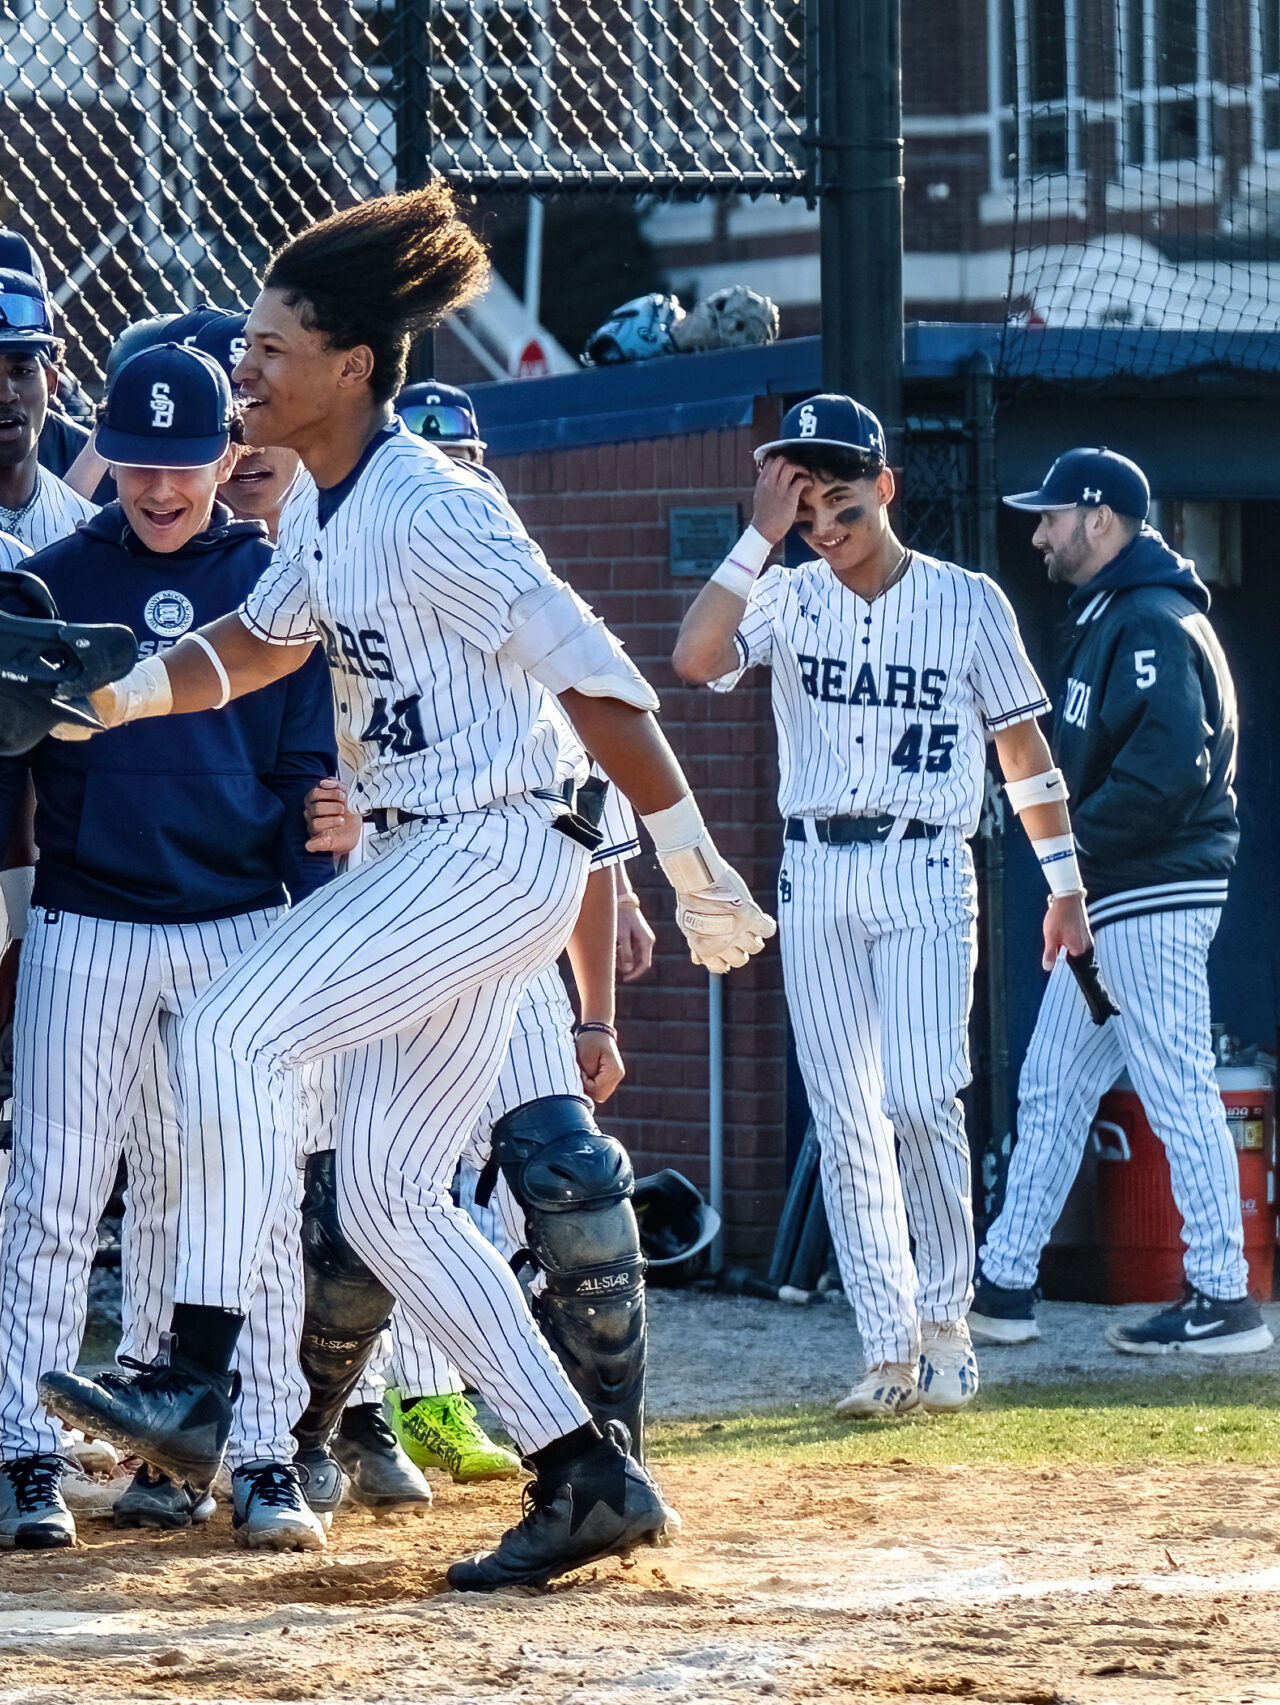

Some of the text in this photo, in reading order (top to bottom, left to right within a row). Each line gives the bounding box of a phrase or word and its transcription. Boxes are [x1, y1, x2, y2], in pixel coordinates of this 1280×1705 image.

[149, 381, 176, 429] SB
[798, 404, 818, 438] SB
[797, 653, 948, 712] BEARS
[1133, 649, 1157, 690] 5
[891, 723, 960, 774] 45
[576, 1272, 629, 1292] ALL-STAR
